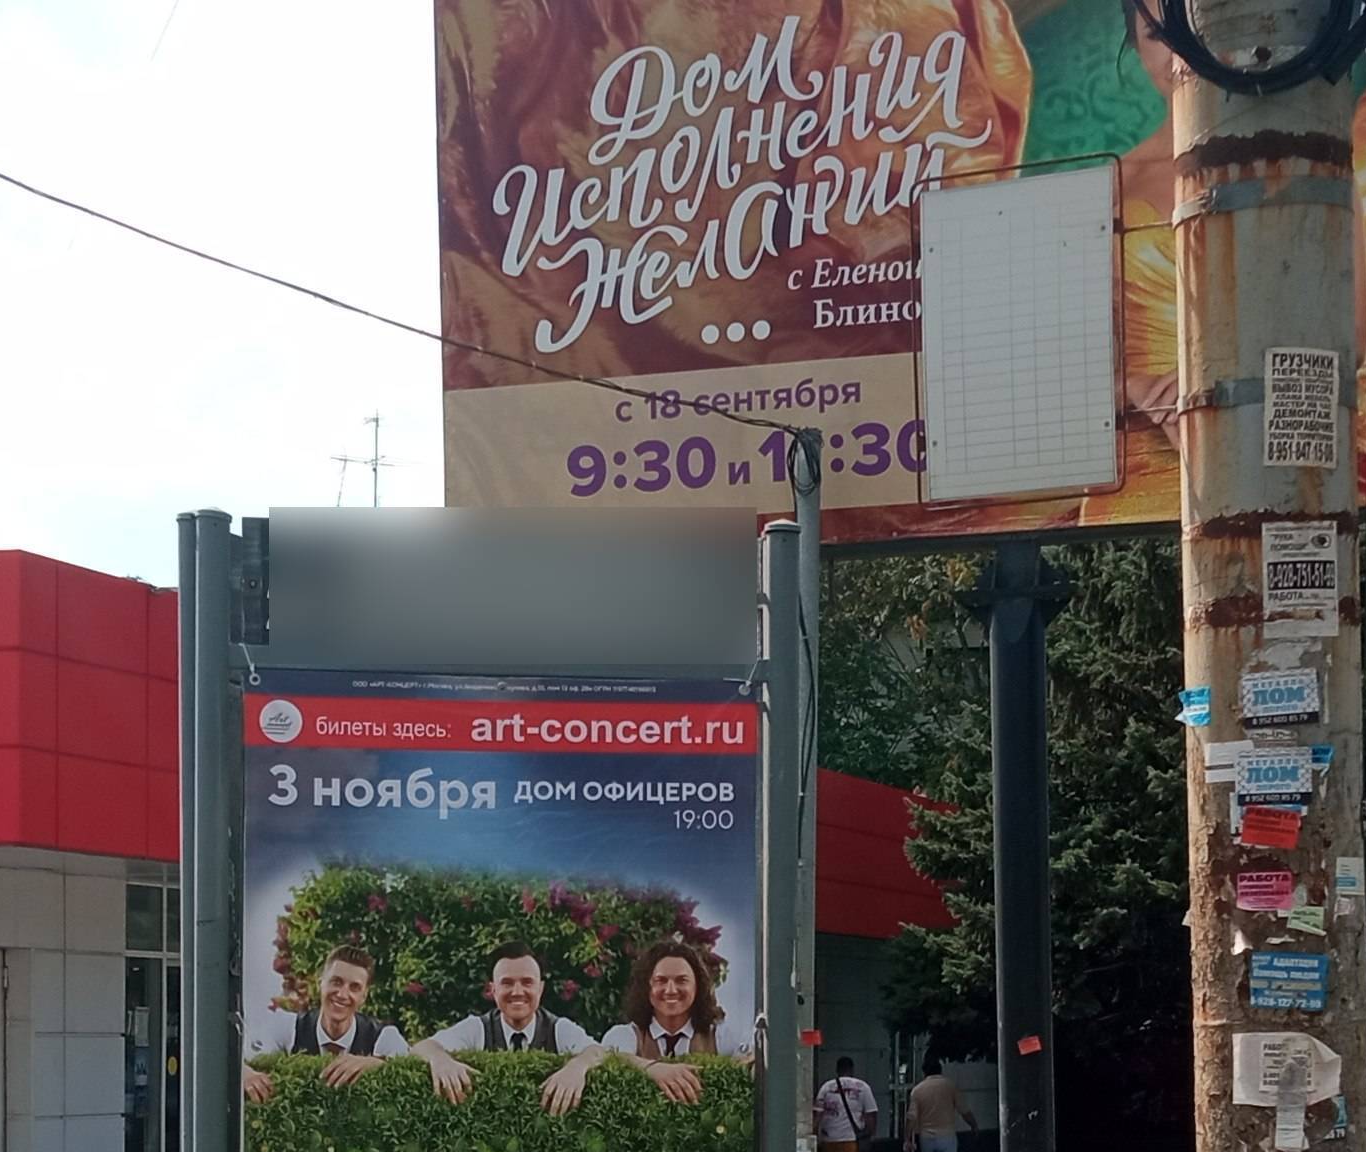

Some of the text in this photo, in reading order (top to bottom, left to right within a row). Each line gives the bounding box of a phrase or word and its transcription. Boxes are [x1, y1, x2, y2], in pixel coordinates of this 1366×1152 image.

[589, 15, 823, 166] Дом
[492, 30, 967, 277] Исполнения
[787, 269, 804, 291] с
[1272, 353, 1334, 369] ГРУЗЧИКИ
[614, 398, 632, 422] с
[693, 378, 862, 417] сентября
[1273, 409, 1331, 420] ДЕМОНТАЖ
[566, 434, 717, 498] 9:30
[727, 458, 751, 487] и
[1252, 686, 1308, 706] ЛОМ
[316, 714, 744, 745] билеты здесь: art-concert.ru
[1246, 766, 1300, 783] ЛОМ
[268, 764, 735, 819] 3 ноября ДОМ ОФИЦЕРОВ
[673, 808, 734, 830] 19:00
[1239, 874, 1289, 882] РАБОТА
